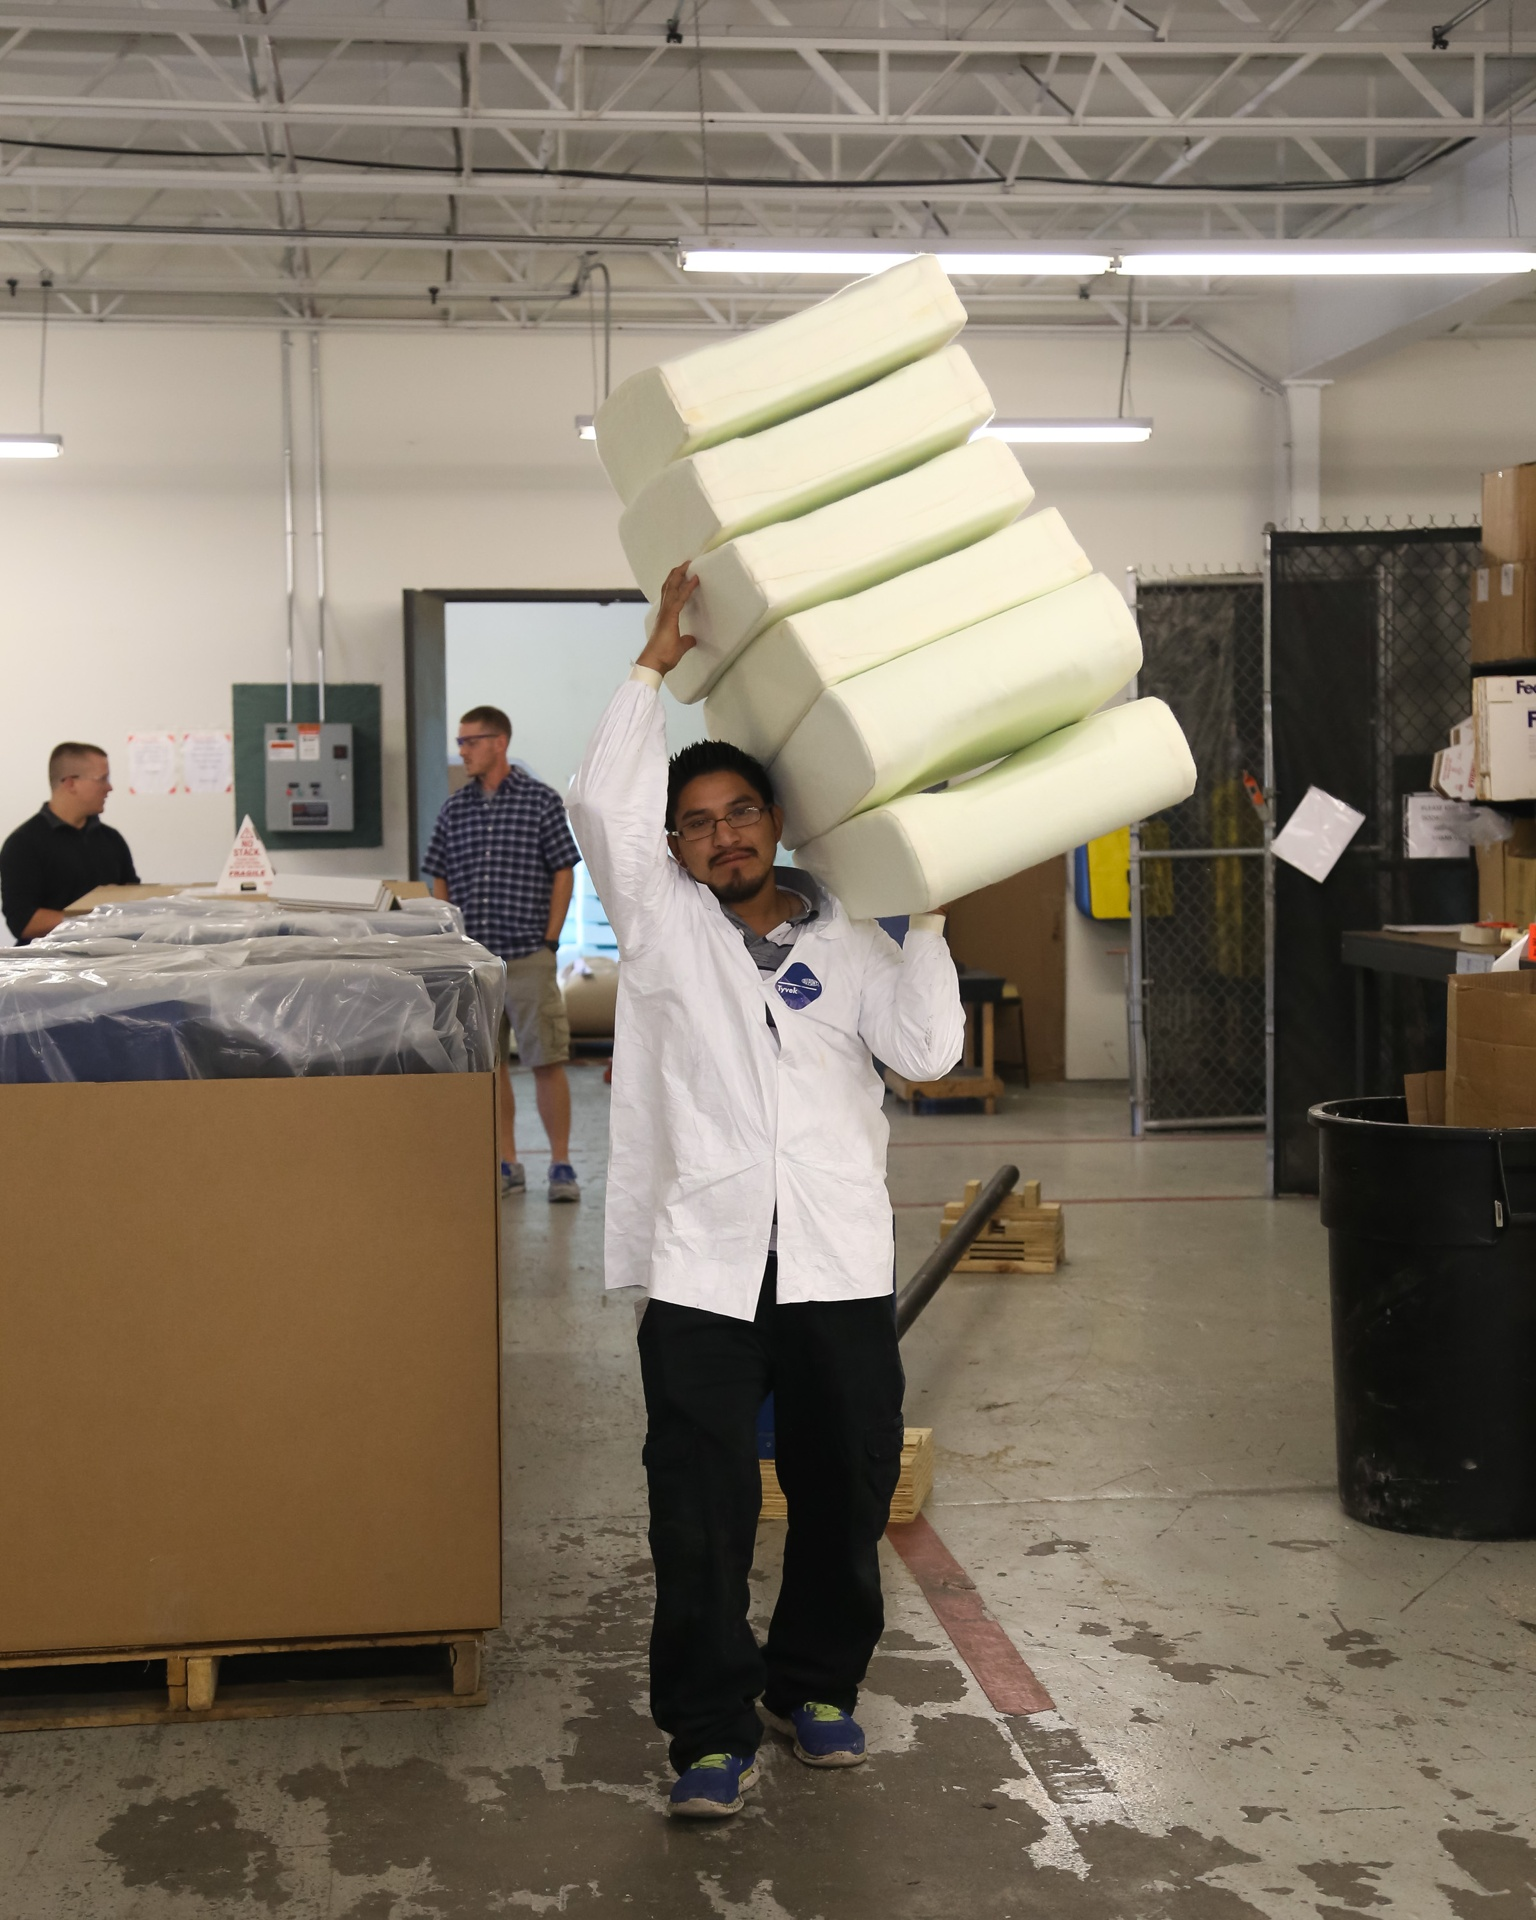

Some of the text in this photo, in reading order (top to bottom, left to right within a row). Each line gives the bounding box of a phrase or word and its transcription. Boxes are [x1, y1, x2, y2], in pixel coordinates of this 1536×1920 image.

[1516, 680, 1536, 694] Fe
[234, 848, 260, 856] STACK
[777, 985, 798, 995] Tyvek
